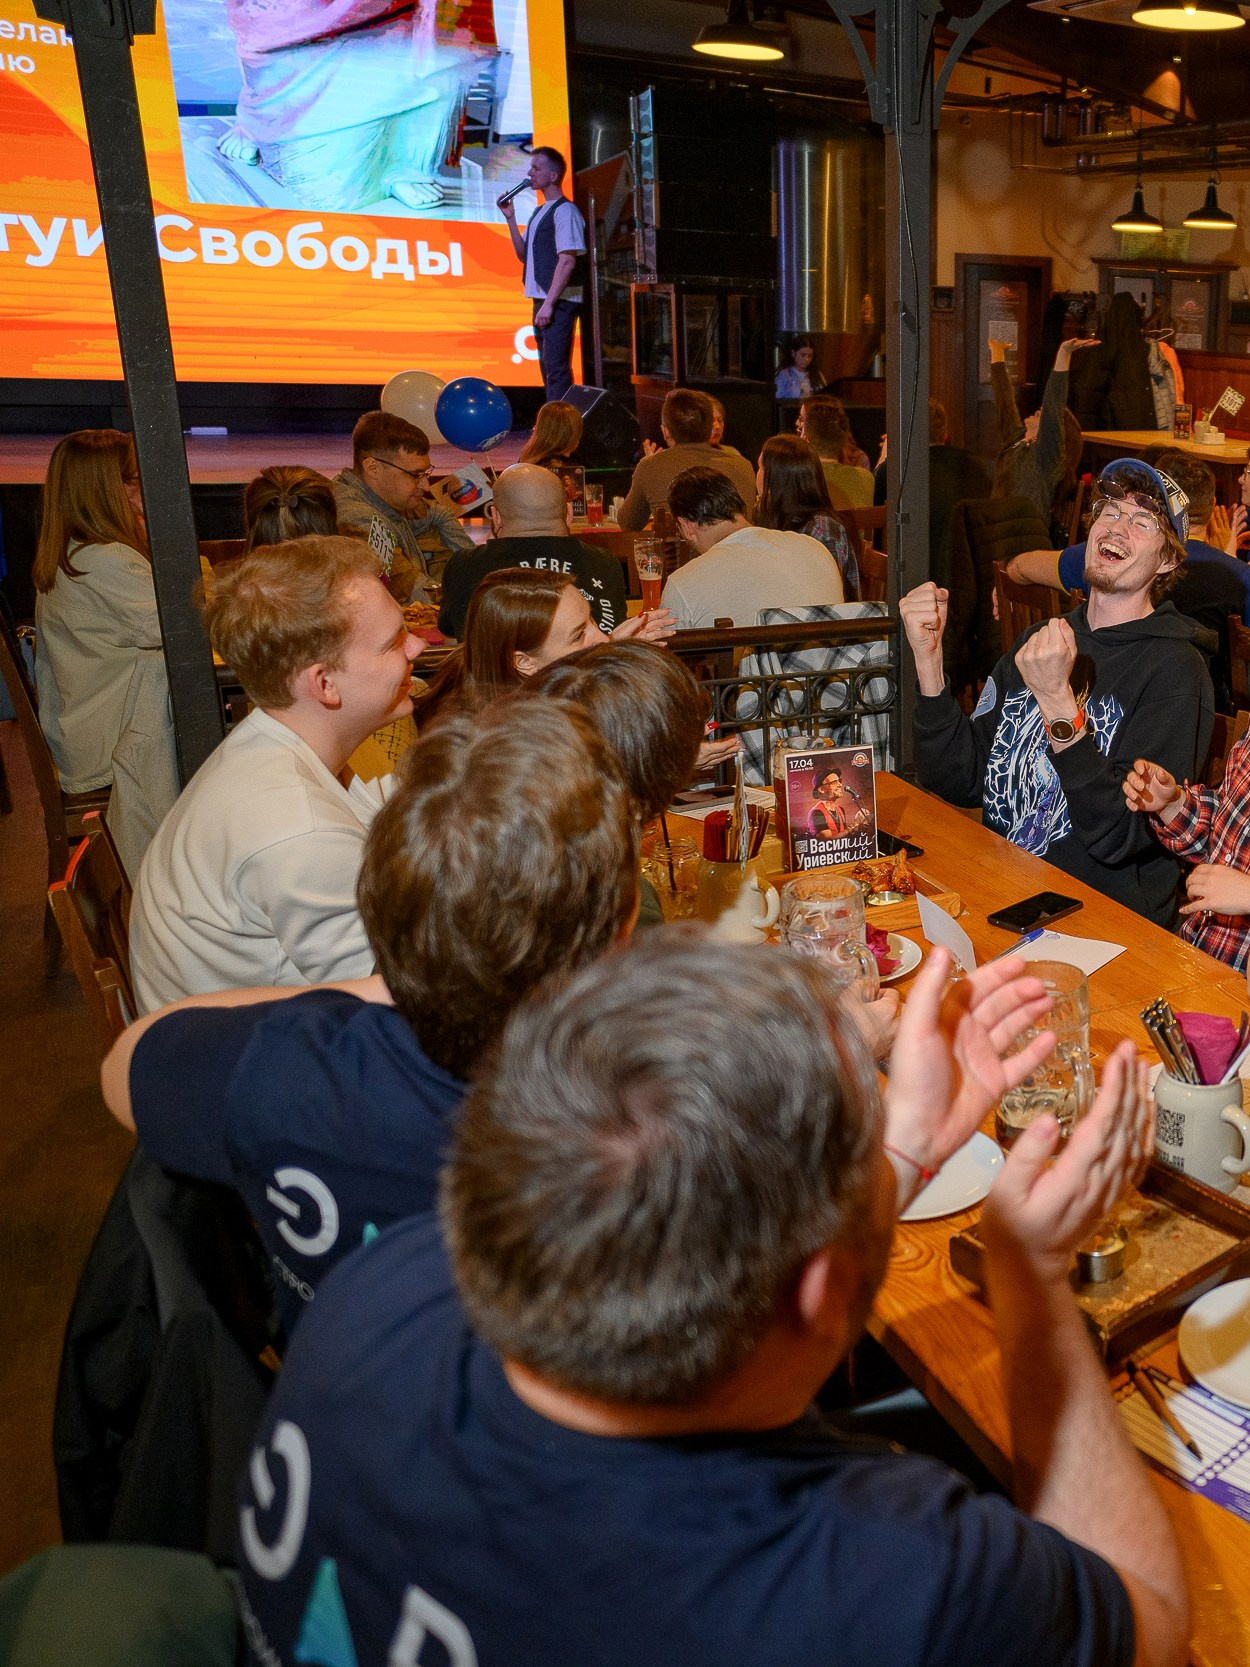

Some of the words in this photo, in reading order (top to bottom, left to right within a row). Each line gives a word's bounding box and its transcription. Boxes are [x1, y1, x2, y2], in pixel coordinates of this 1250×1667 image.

[154, 213, 464, 281] Свободы
[788, 758, 814, 769] 17.04
[810, 832, 873, 854] Василий
[796, 846, 873, 871] Уриевский
